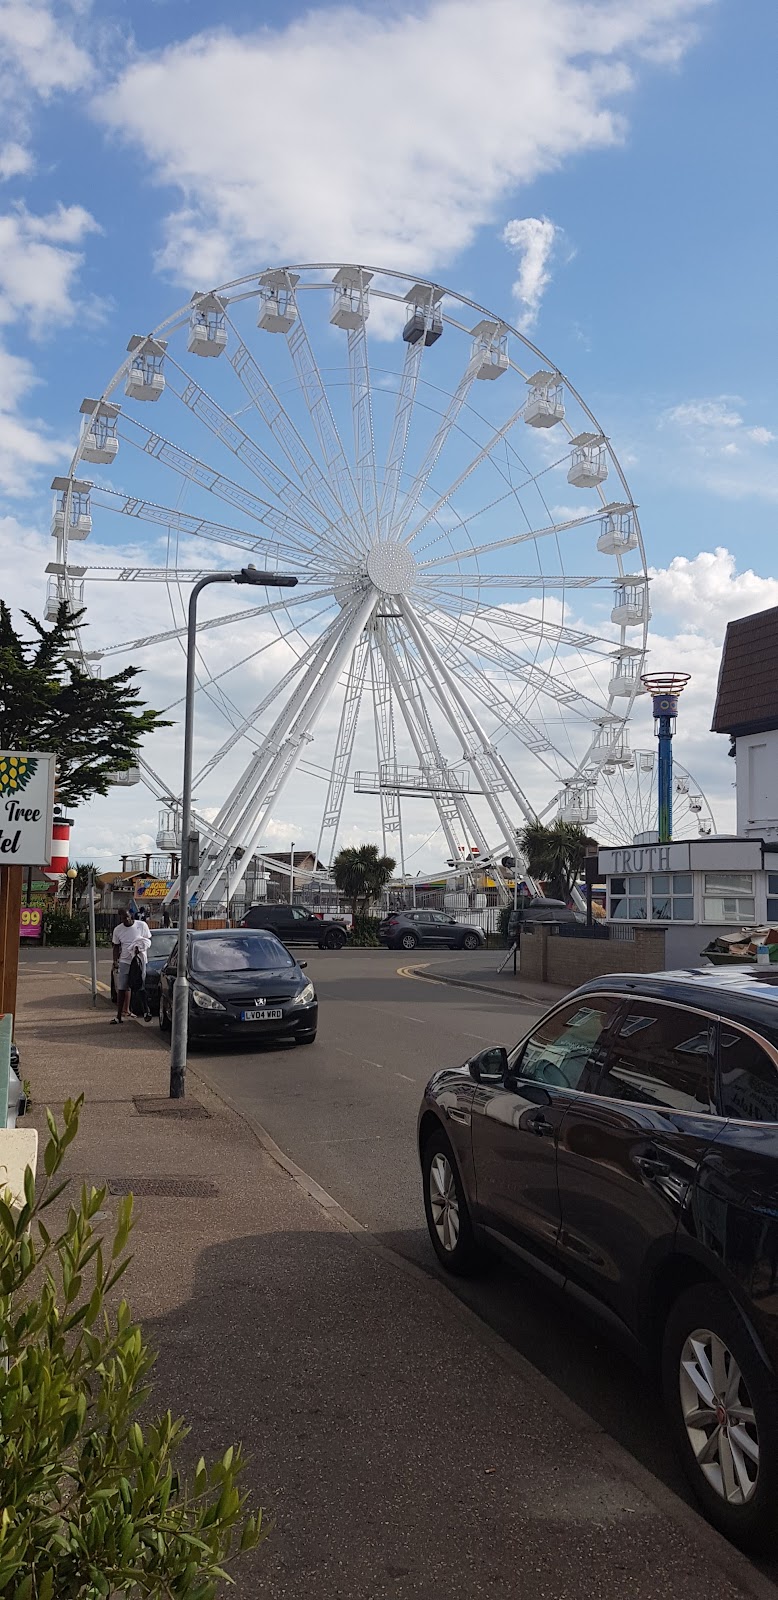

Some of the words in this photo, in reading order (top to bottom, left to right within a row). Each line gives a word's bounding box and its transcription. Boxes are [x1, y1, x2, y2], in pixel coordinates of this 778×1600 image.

[5, 800, 42, 822] Tree
[611, 847, 671, 873] TRUTH
[21, 910, 40, 926] 99
[245, 1011, 265, 1019] LV04
[266, 1010, 281, 1018] WRD
